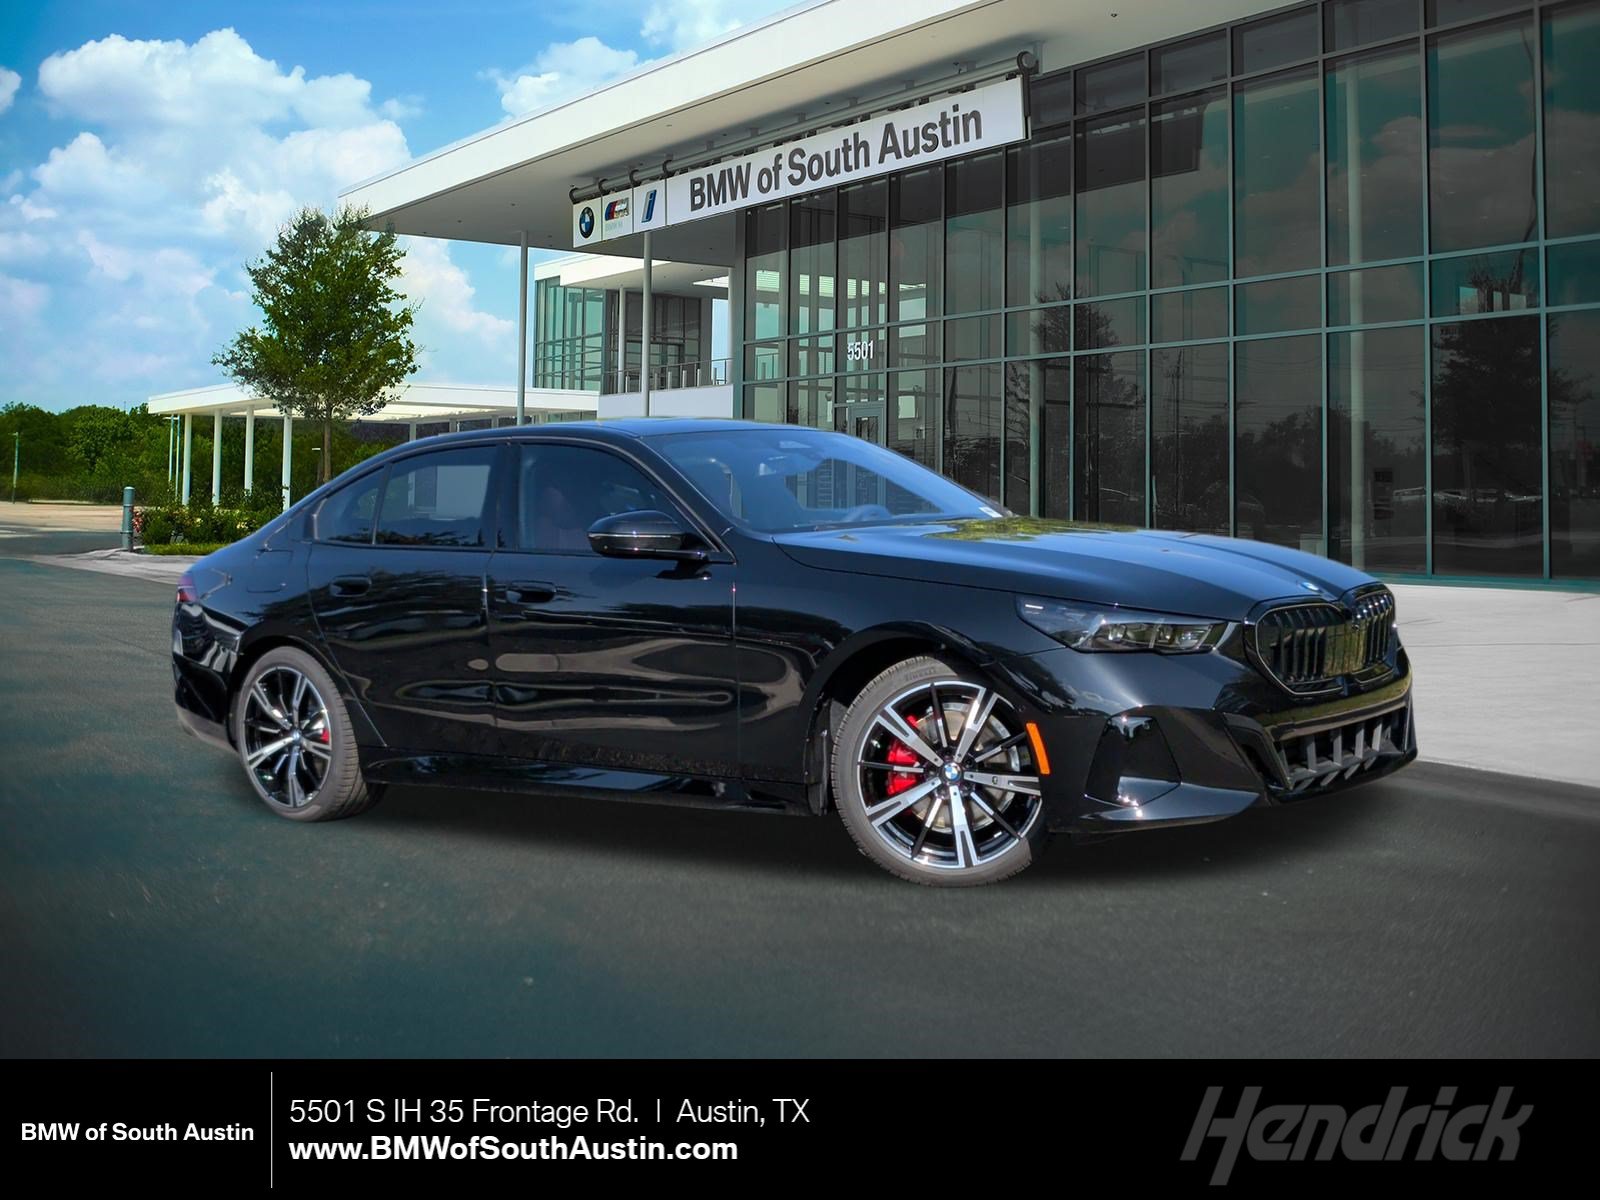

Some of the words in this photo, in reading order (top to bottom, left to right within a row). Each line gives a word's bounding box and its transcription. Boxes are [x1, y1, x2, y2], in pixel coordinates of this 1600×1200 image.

[690, 162, 752, 212] BMW
[757, 151, 783, 194] of
[787, 131, 871, 187] South
[878, 103, 983, 165] Austin
[847, 340, 873, 361] 5501
